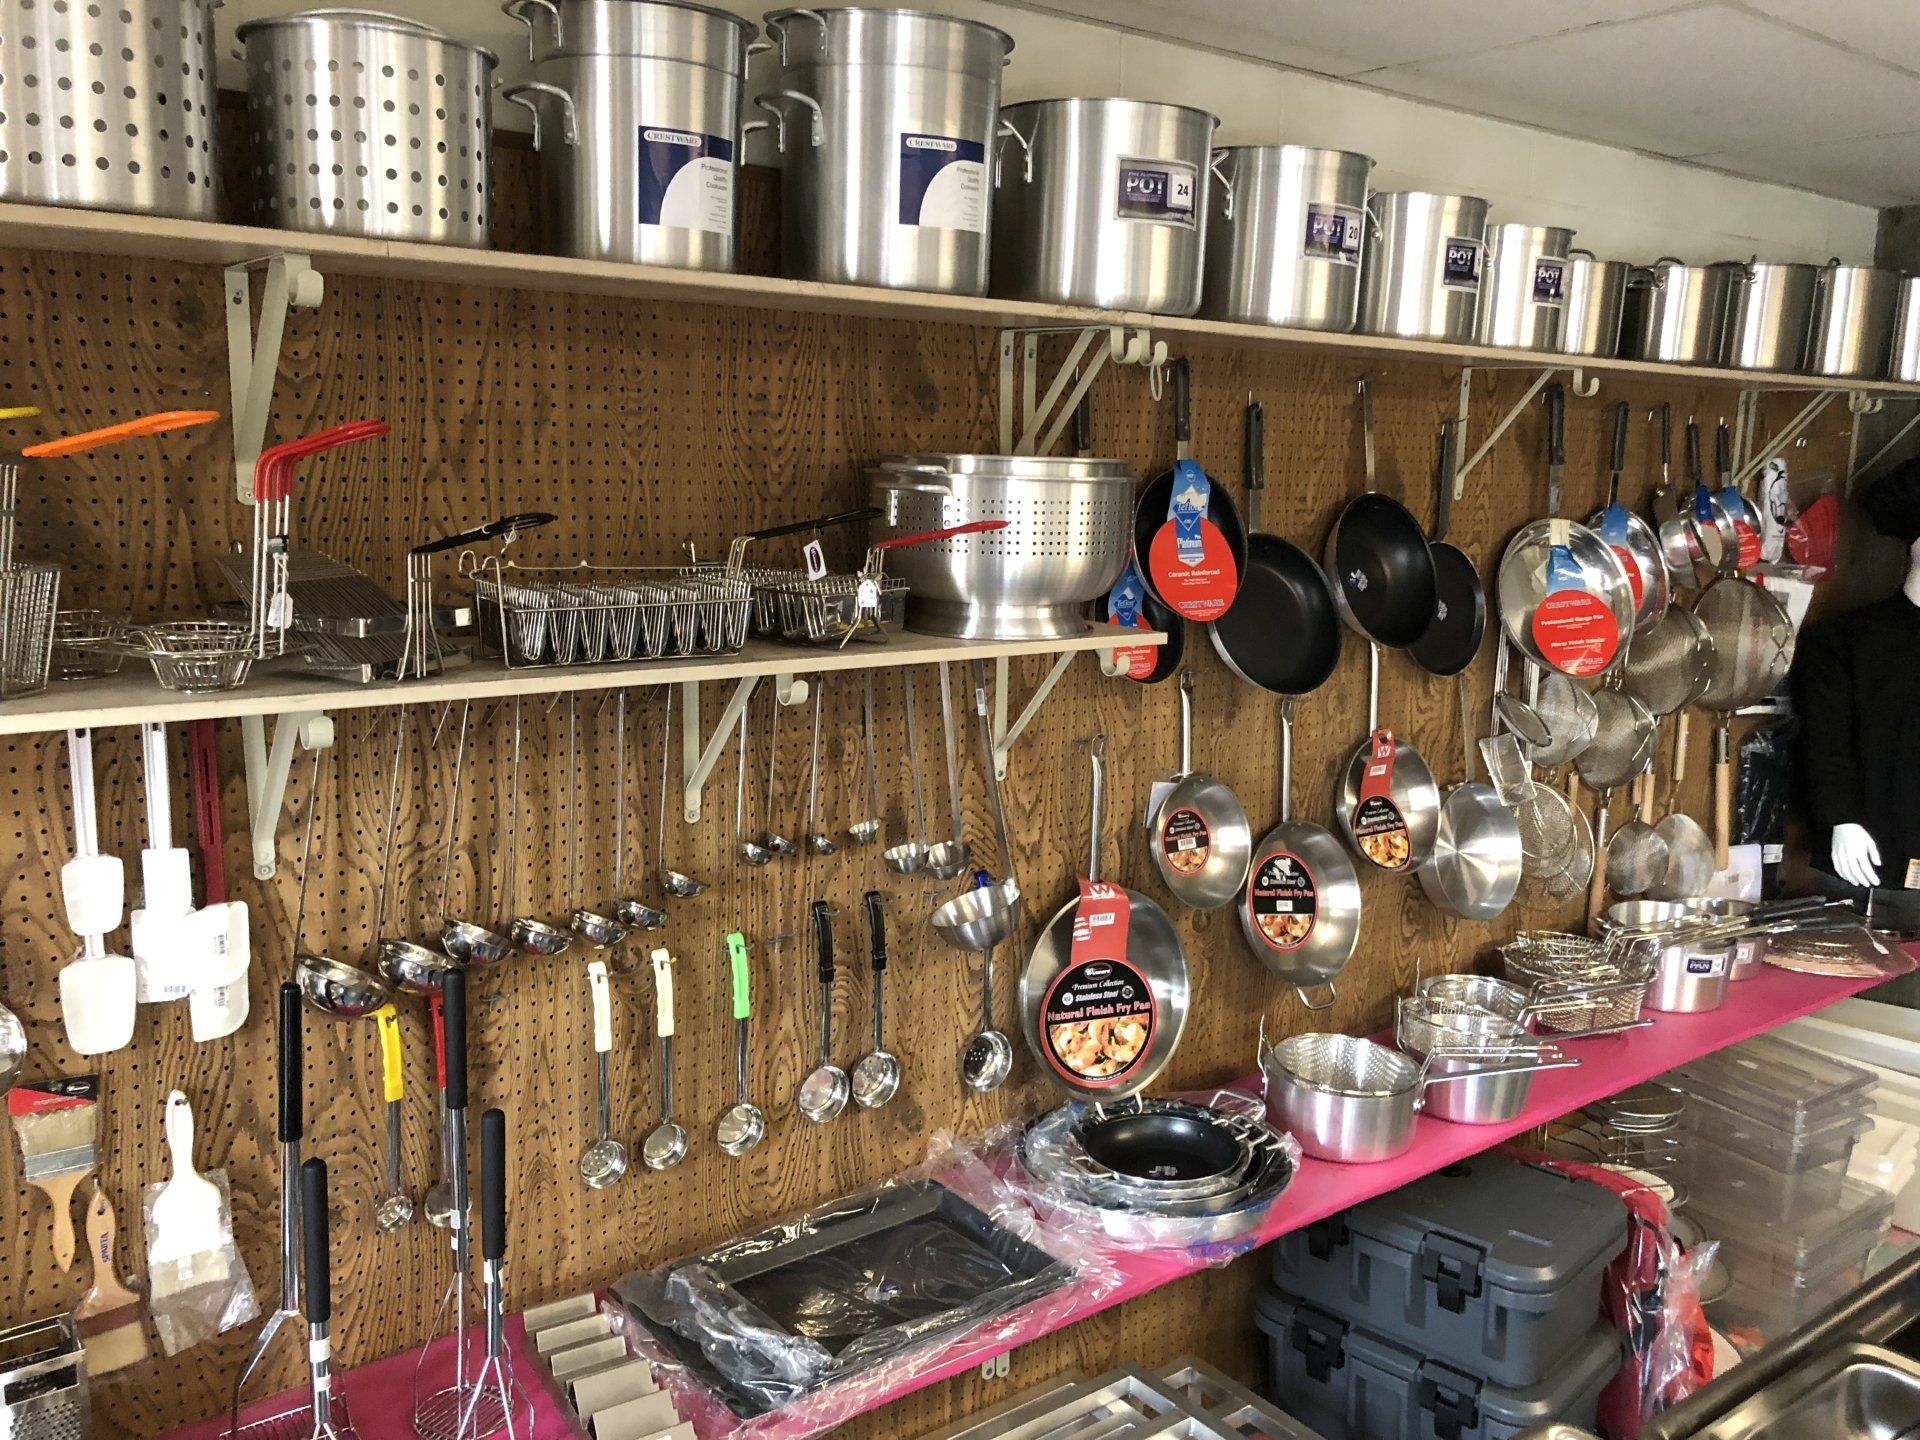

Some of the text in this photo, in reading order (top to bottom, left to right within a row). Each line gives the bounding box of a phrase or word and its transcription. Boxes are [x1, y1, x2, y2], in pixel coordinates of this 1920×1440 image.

[647, 131, 699, 145] CRESTWARE
[909, 139, 955, 150] CRESTWARE
[1127, 177, 1165, 195] POT
[1177, 183, 1189, 197] 24
[1349, 226, 1359, 240] 20
[1448, 248, 1473, 265] POT
[1537, 267, 1560, 284] POT
[1177, 501, 1200, 511] Teflo
[1255, 889, 1314, 899] Natural Finish Fry Pan
[1689, 962, 1710, 970] PAN
[1072, 979, 1125, 991] Premium Collection
[1075, 990, 1119, 1002] Stainless Steel
[1047, 1001, 1151, 1021] Natural Finish Fry Pan
